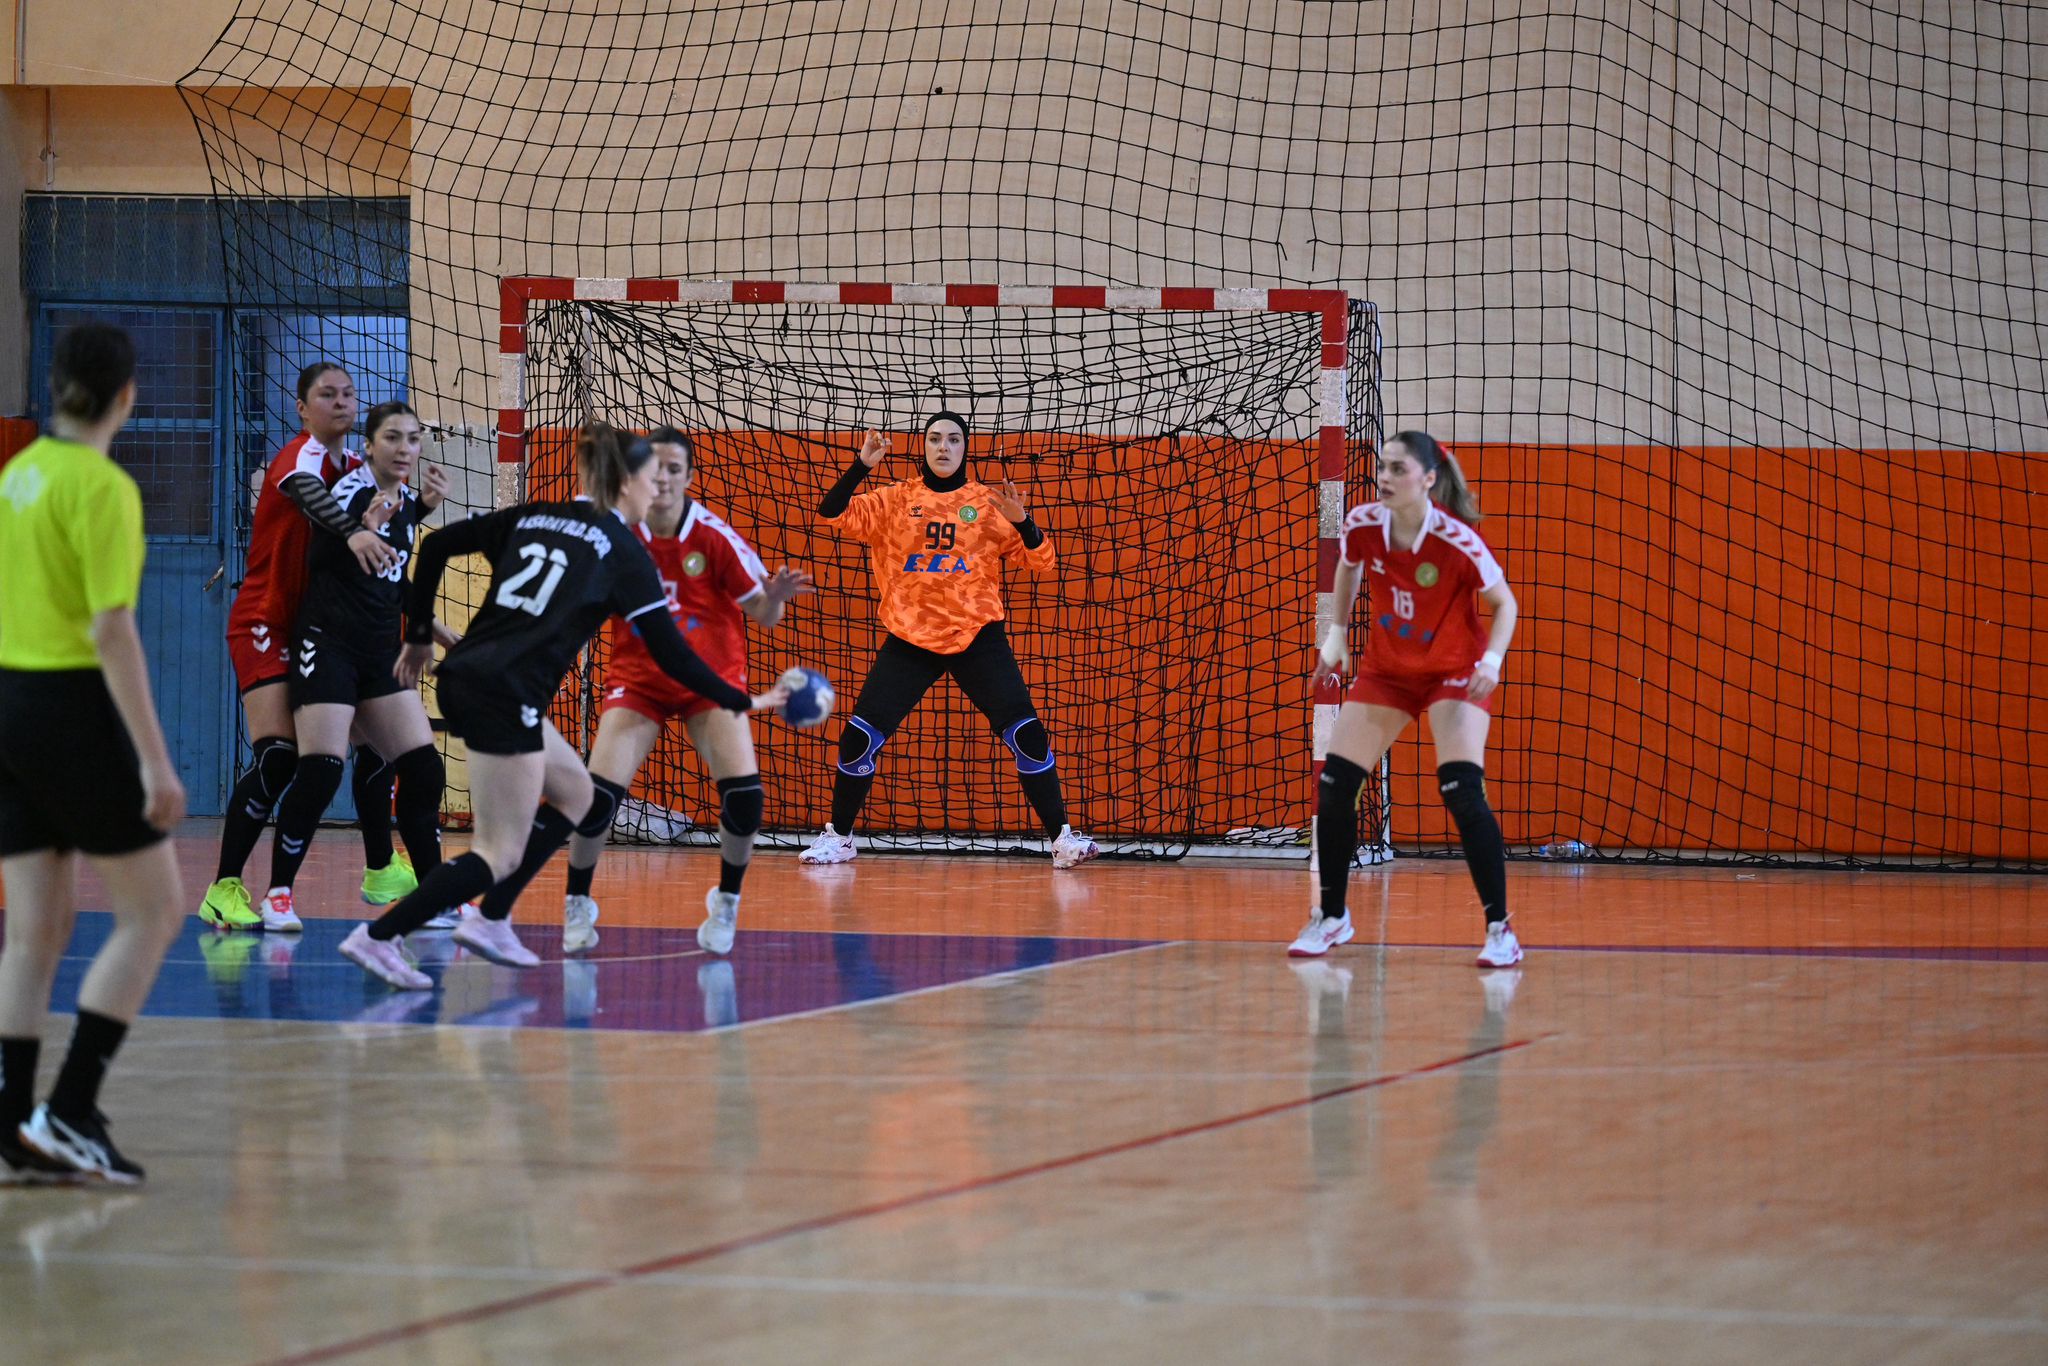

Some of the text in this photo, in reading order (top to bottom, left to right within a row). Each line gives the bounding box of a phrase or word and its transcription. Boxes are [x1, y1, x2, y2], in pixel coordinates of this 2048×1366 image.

[926, 521, 956, 550] 99
[495, 542, 569, 617] 21
[1391, 586, 1415, 621] 18
